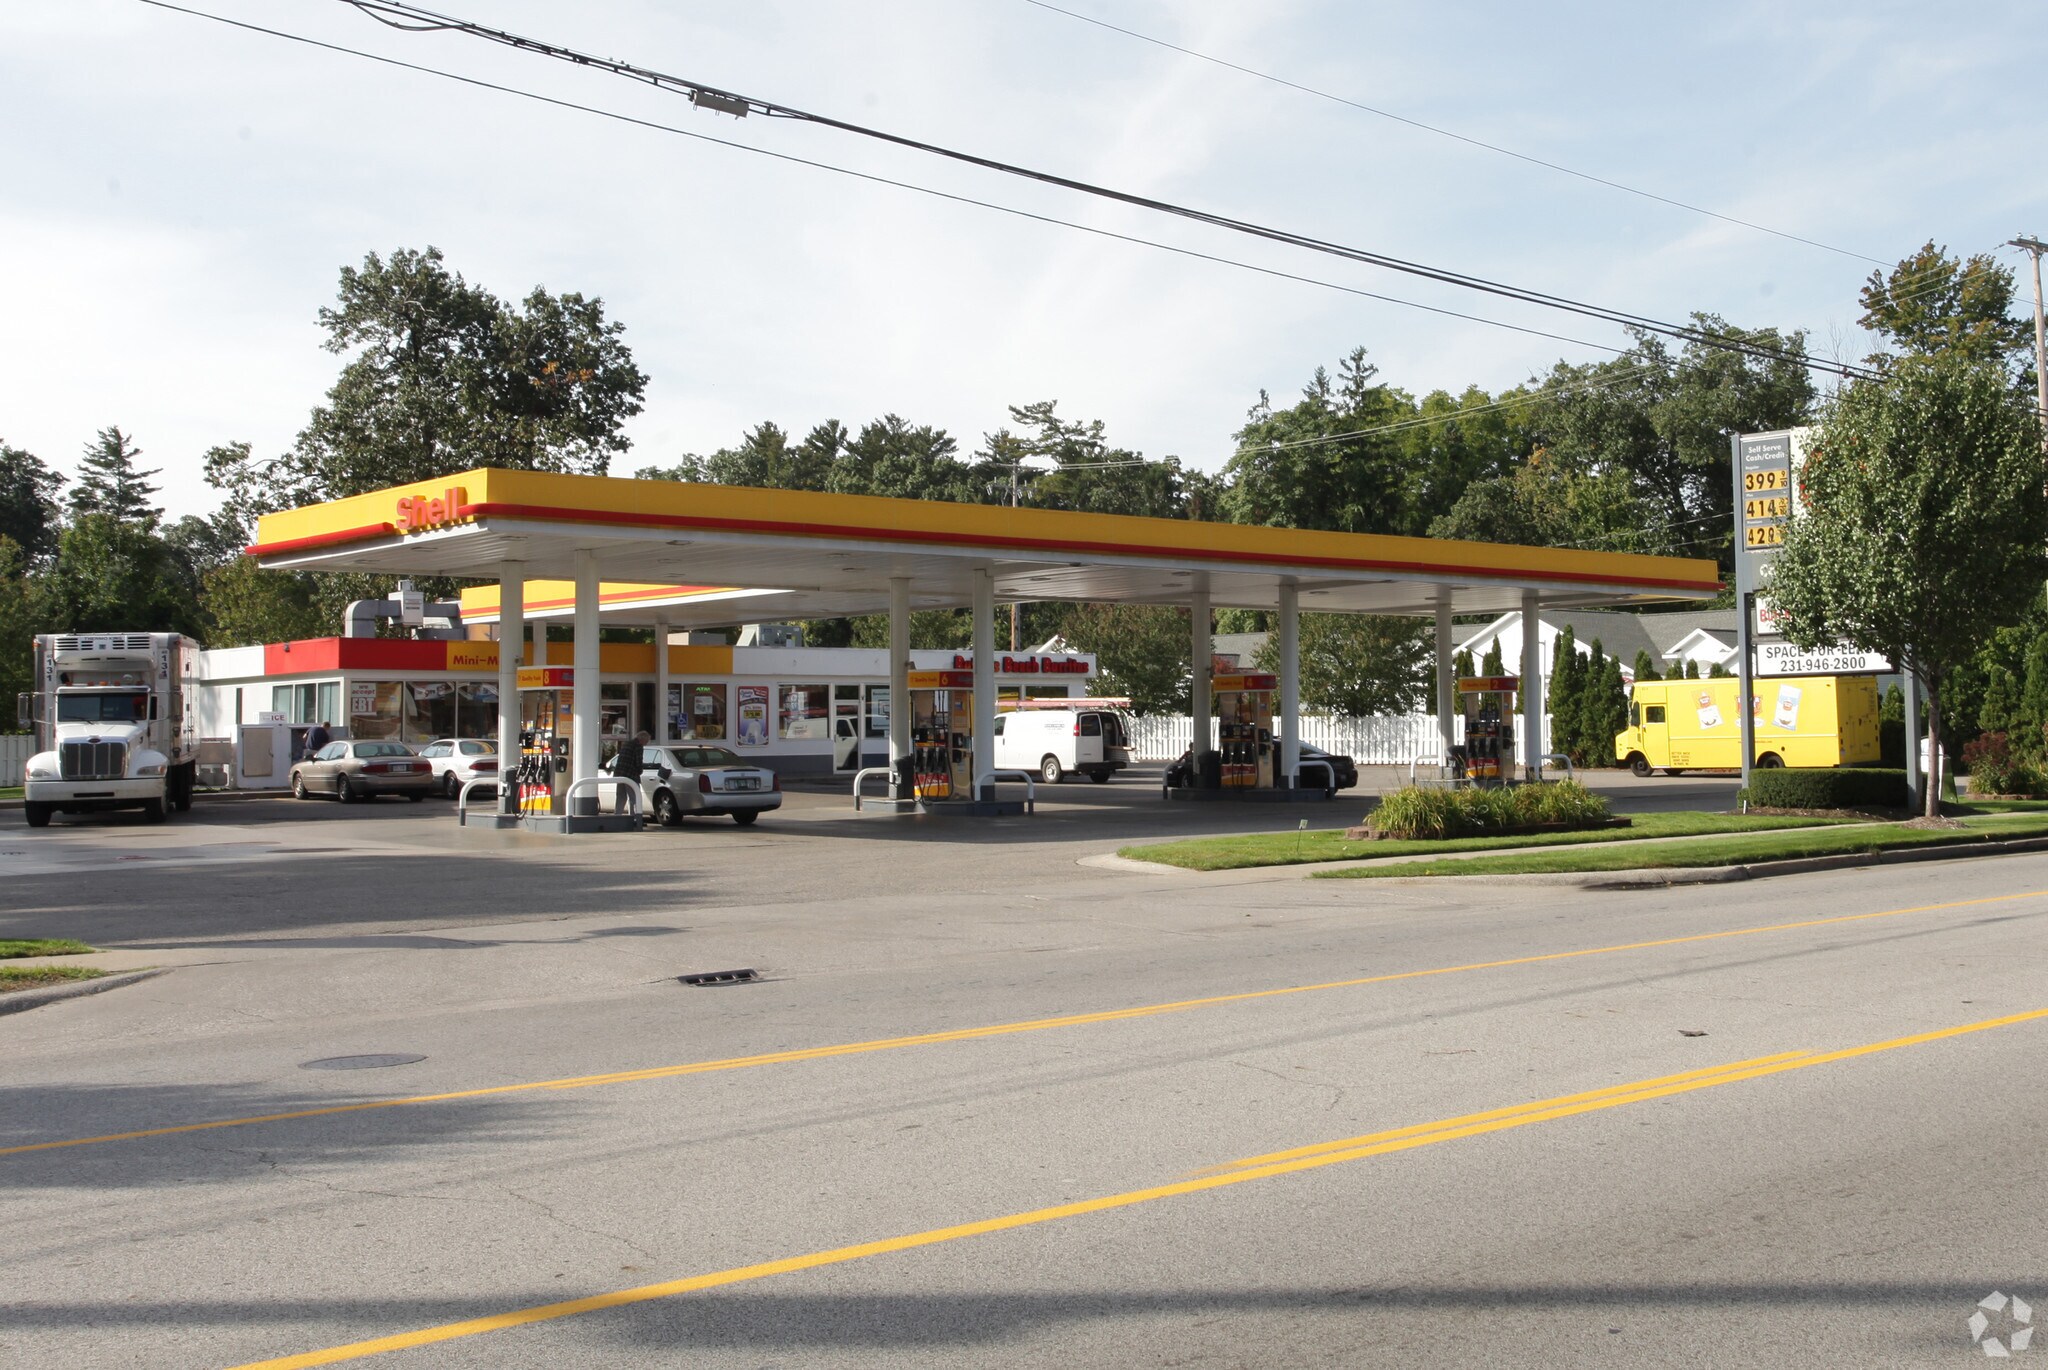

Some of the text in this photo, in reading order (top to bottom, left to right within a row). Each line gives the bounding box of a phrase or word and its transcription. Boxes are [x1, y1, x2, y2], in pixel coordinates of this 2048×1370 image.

[1745, 451, 1785, 462] Cash/Credit
[1746, 472, 1776, 490] 399
[396, 487, 467, 530] Shell
[1747, 499, 1776, 517] 414
[1766, 645, 1805, 659] SPACE
[453, 655, 499, 665] Mini-M
[1003, 656, 1039, 673] Beach
[1042, 657, 1089, 674] Burritos
[1780, 656, 1866, 672] 231-946-2800
[544, 671, 550, 684] 8
[942, 673, 948, 685] 6
[352, 697, 374, 712] EBT
